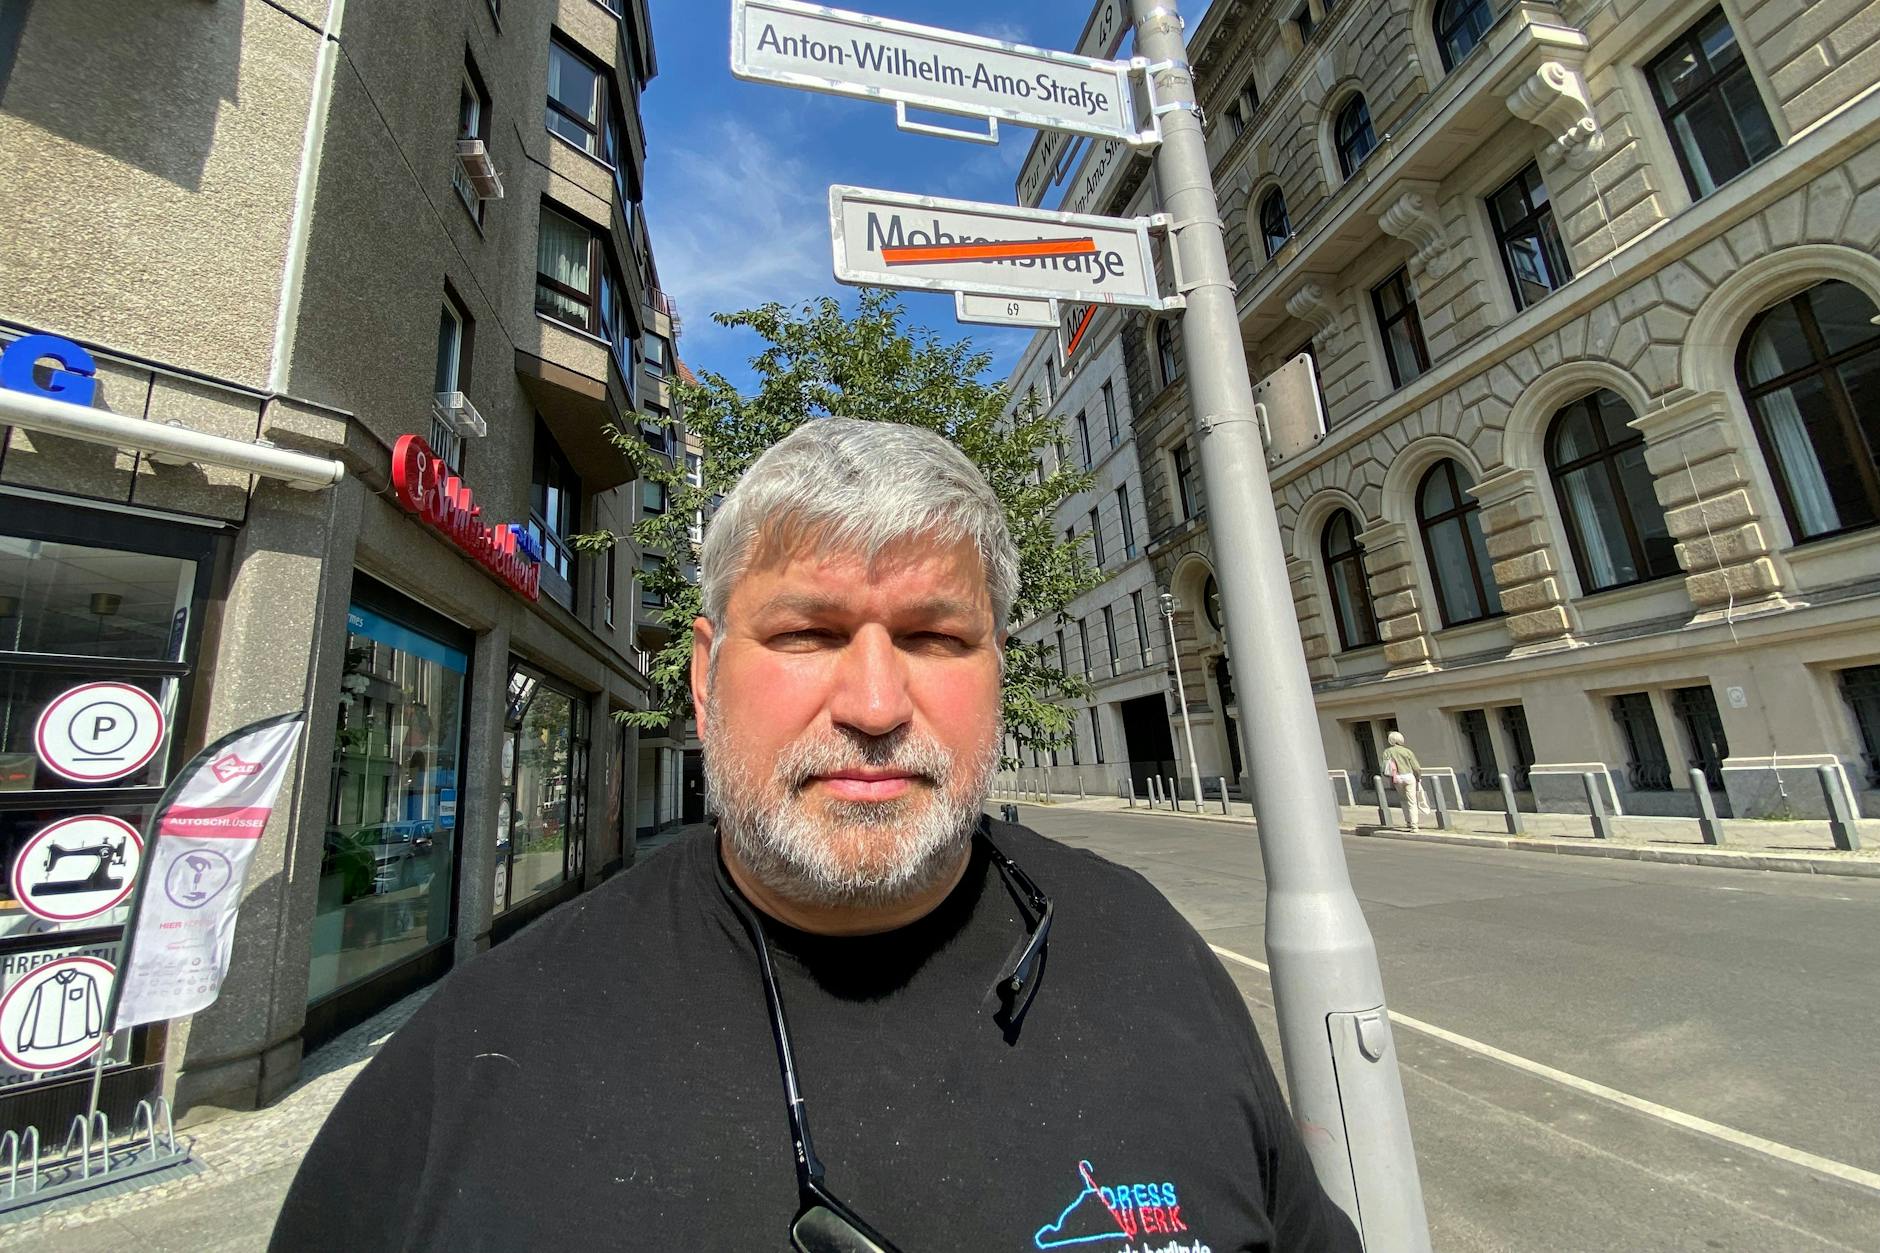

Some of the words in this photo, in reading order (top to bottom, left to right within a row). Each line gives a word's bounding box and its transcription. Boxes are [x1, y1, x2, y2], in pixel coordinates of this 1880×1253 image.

[757, 24, 1109, 115] Anton-Wilhelm-Amo-Straße
[1025, 164, 1040, 202] Zur
[1075, 139, 1121, 213] lm-Amo-Str
[1007, 303, 1019, 317] 69
[0, 334, 97, 408] G
[92, 716, 116, 741] P
[170, 817, 265, 828] AUTOSCHLÜSSEL
[1099, 1182, 1178, 1209] DRESS
[1110, 1204, 1188, 1239] WERK
